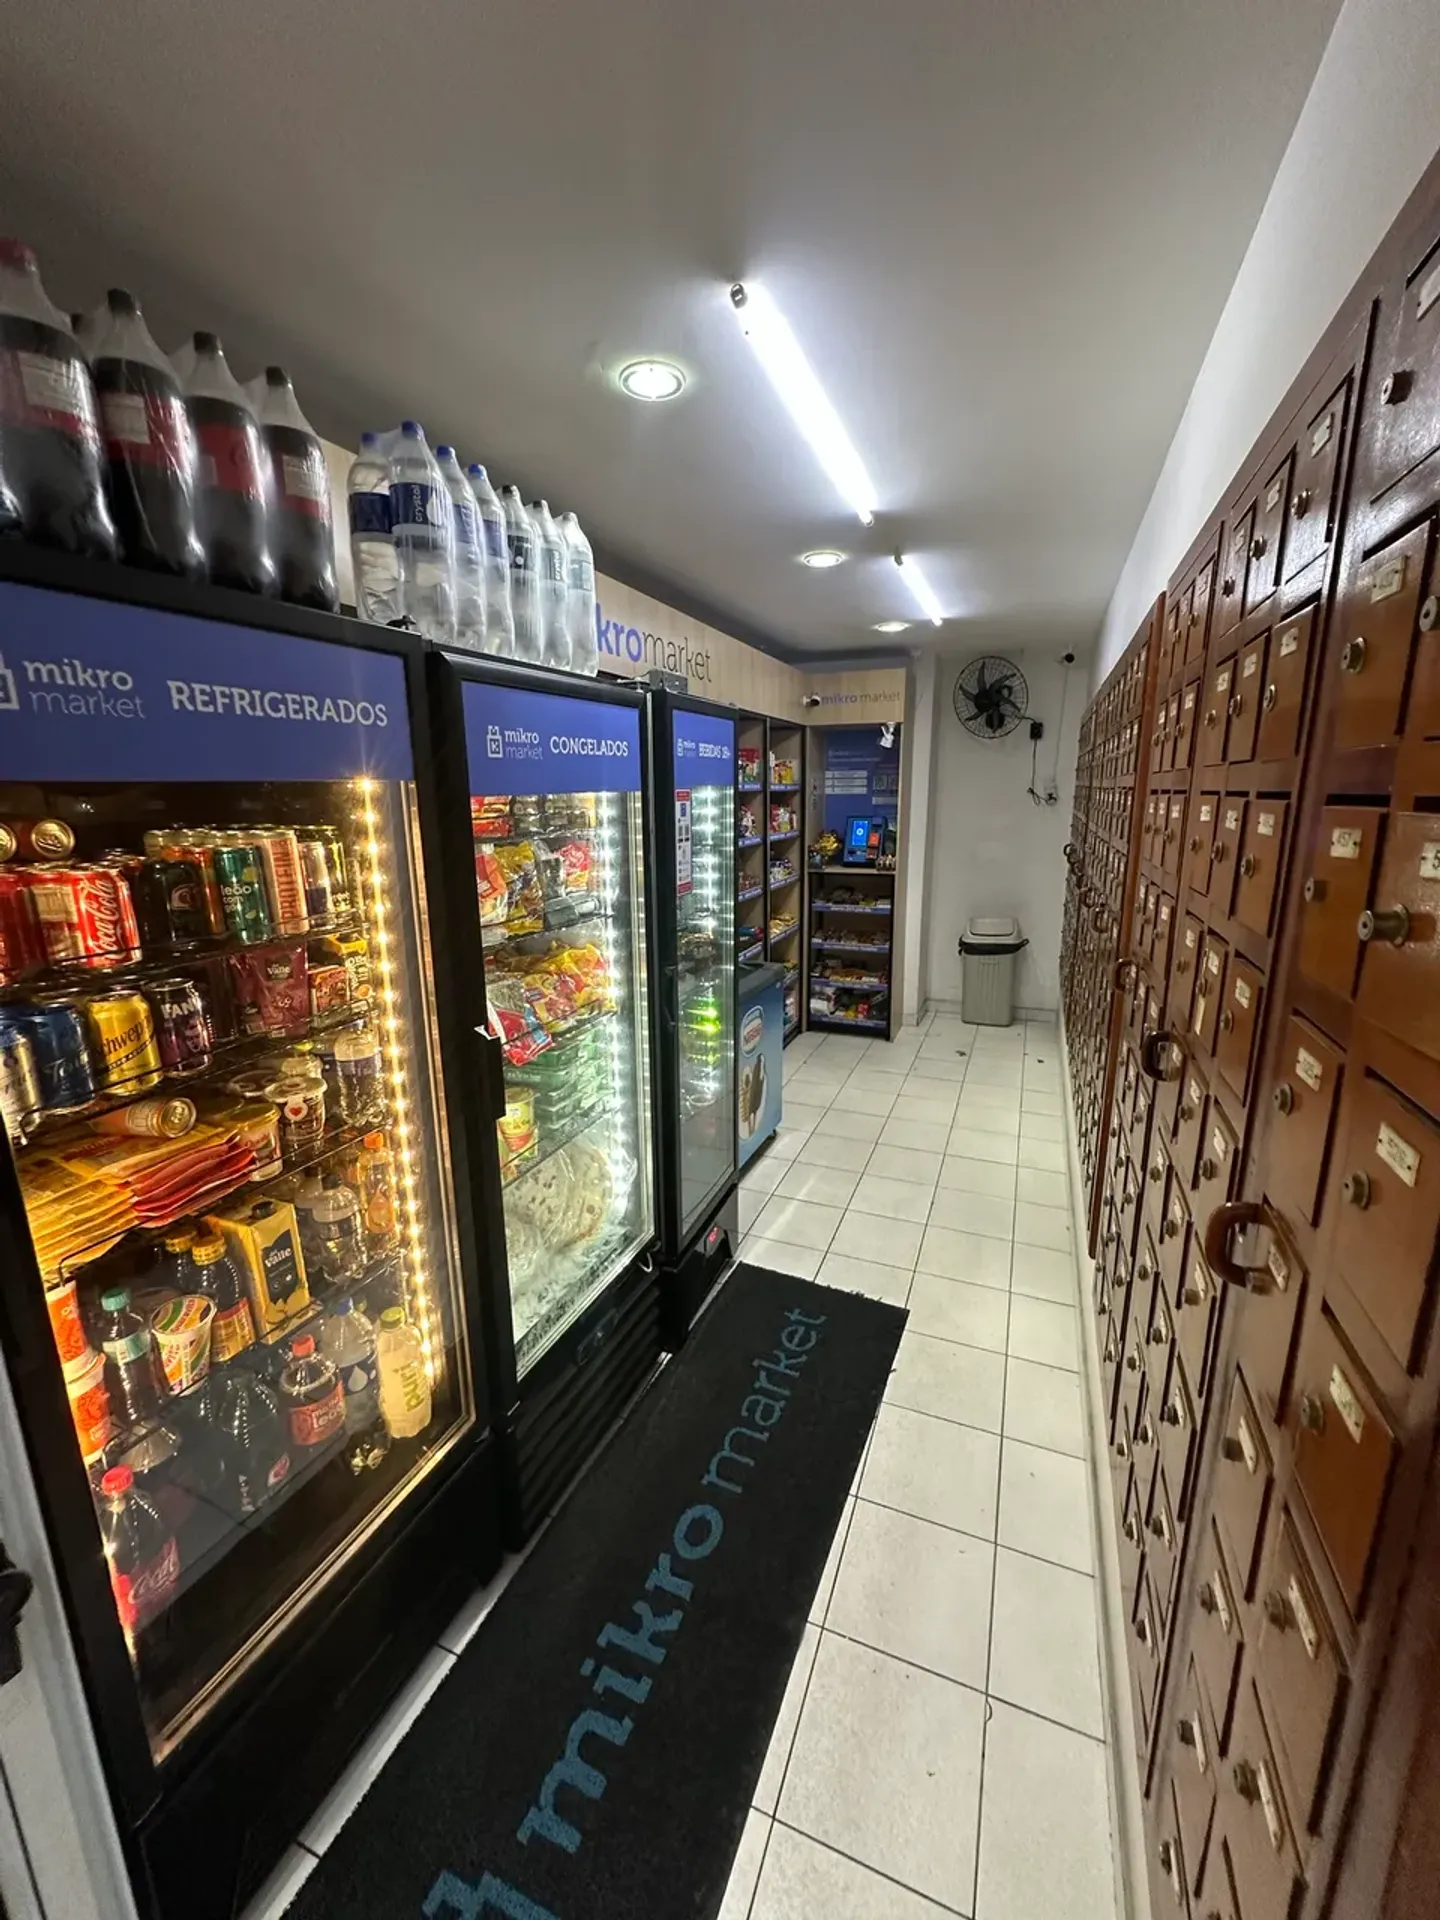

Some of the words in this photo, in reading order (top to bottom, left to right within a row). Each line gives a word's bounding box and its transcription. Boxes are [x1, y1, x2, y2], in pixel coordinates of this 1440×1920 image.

[22, 657, 134, 691] mikro
[29, 690, 146, 719] market
[166, 679, 388, 727] REFRIGERADOS
[504, 727, 540, 744] mikro
[549, 735, 629, 757] CONGELADOS
[505, 743, 544, 760] market
[701, 1306, 828, 1493] market
[515, 1503, 725, 1853] mikro
